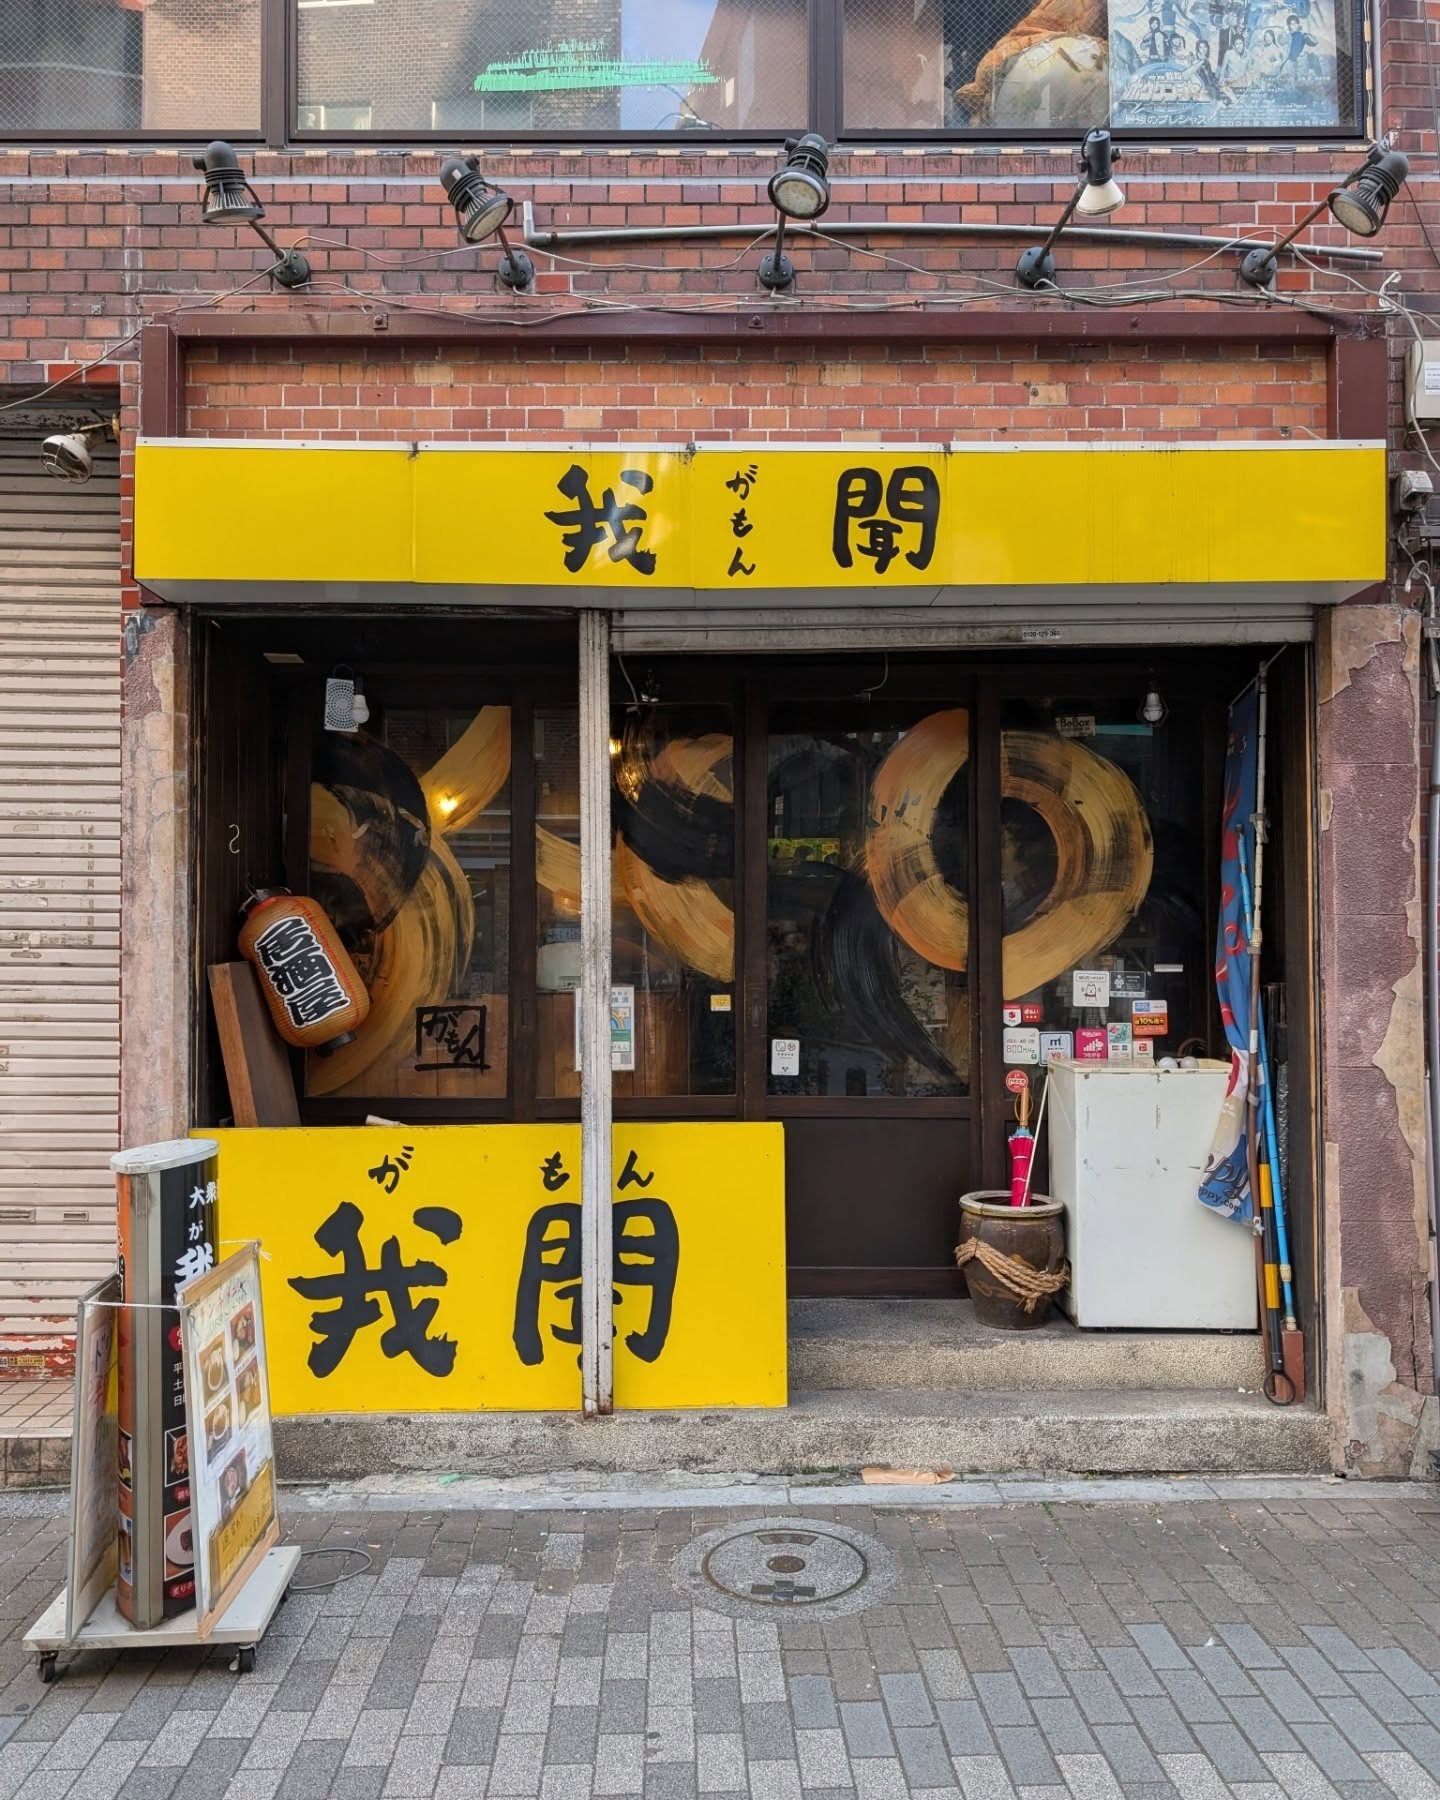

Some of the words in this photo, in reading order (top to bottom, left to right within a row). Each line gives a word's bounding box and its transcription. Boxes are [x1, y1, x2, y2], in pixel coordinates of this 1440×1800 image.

[725, 464, 758, 577] がもん
[189, 1180, 219, 1209] 大衆
